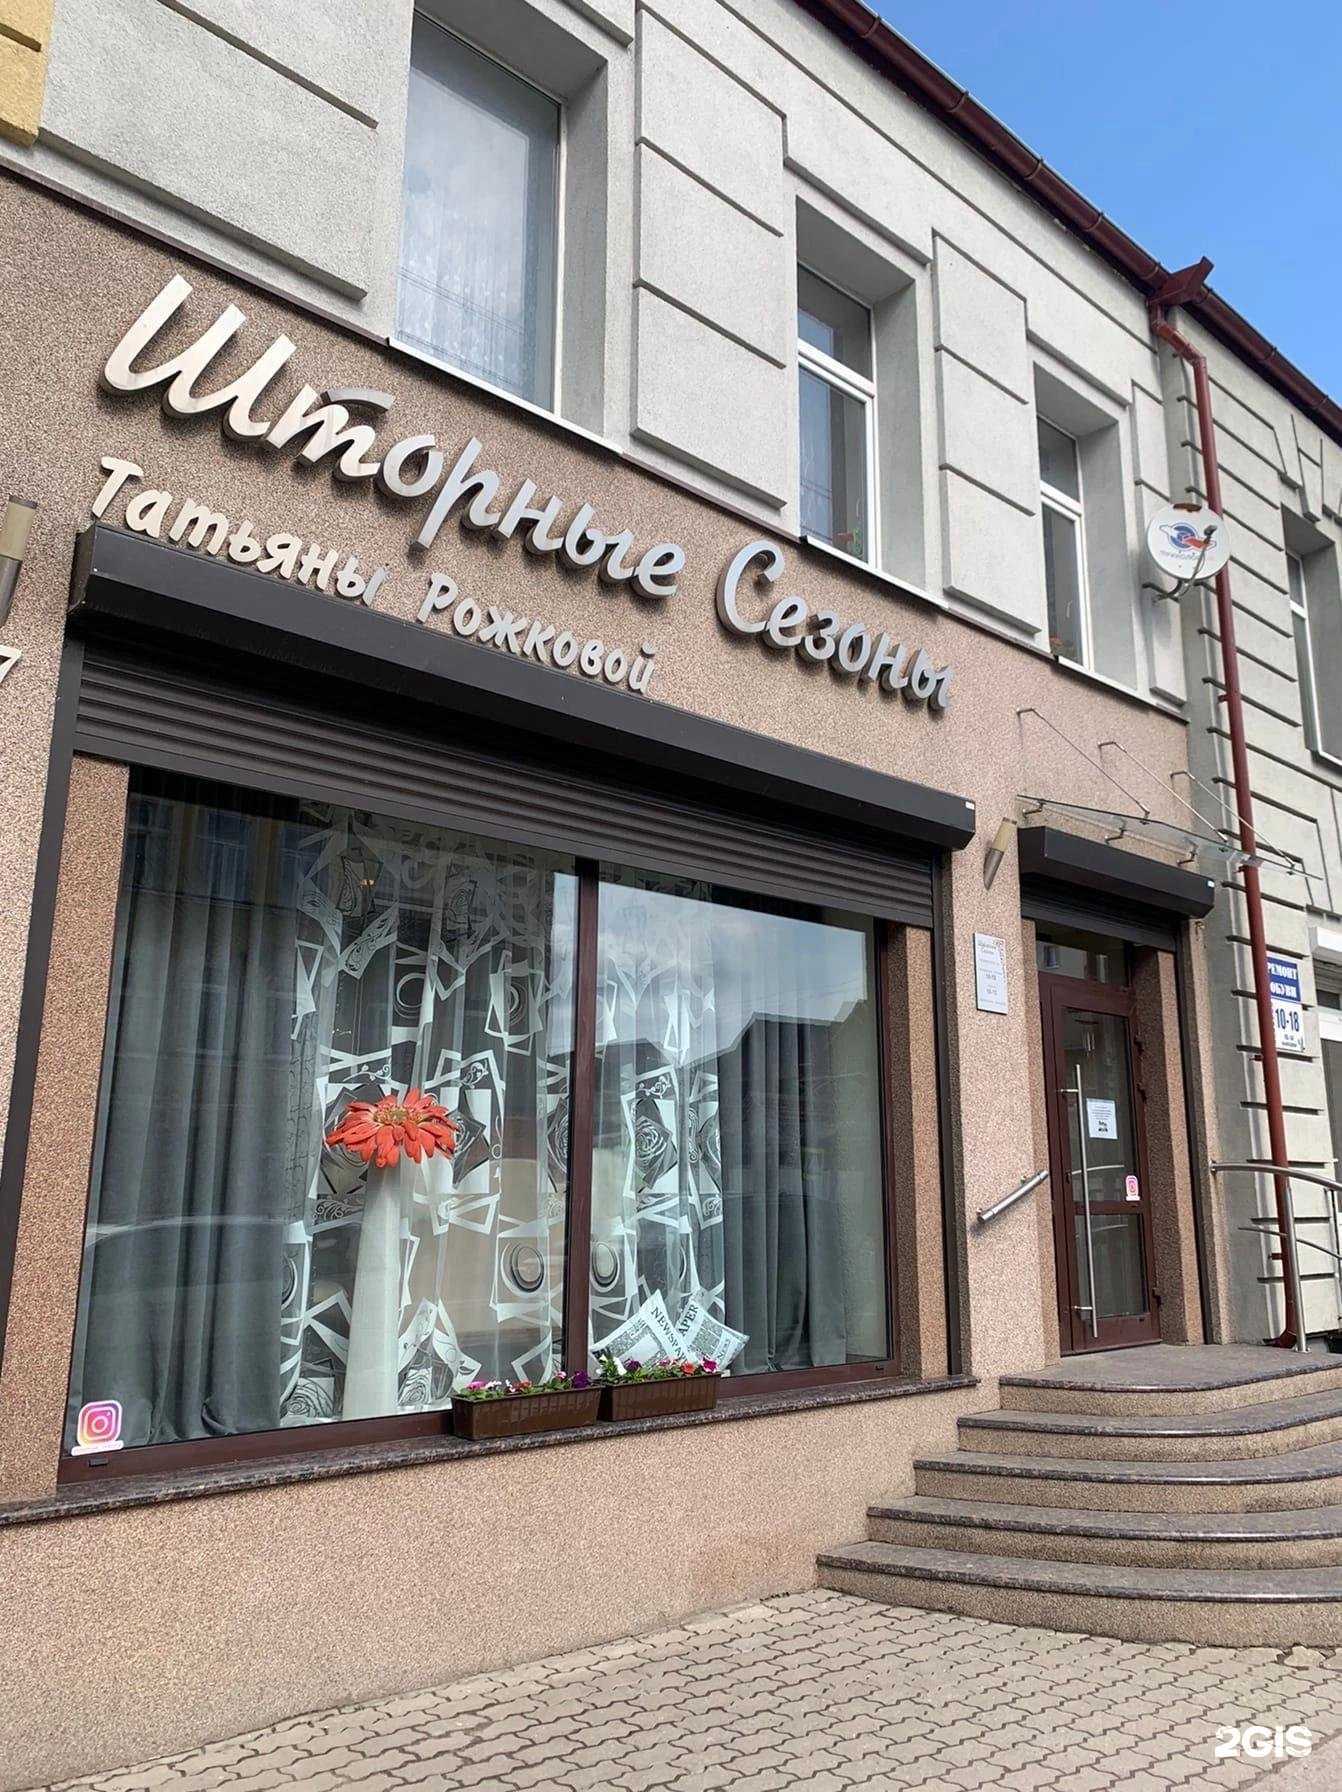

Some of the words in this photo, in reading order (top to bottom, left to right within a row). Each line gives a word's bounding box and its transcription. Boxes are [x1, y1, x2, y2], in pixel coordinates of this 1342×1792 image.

[90, 456, 390, 606] Татьяны
[416, 571, 656, 696] Рожковой
[104, 274, 686, 600] Шторные
[716, 539, 956, 712] Сезоны
[1275, 1008, 1300, 1032] 10-18
